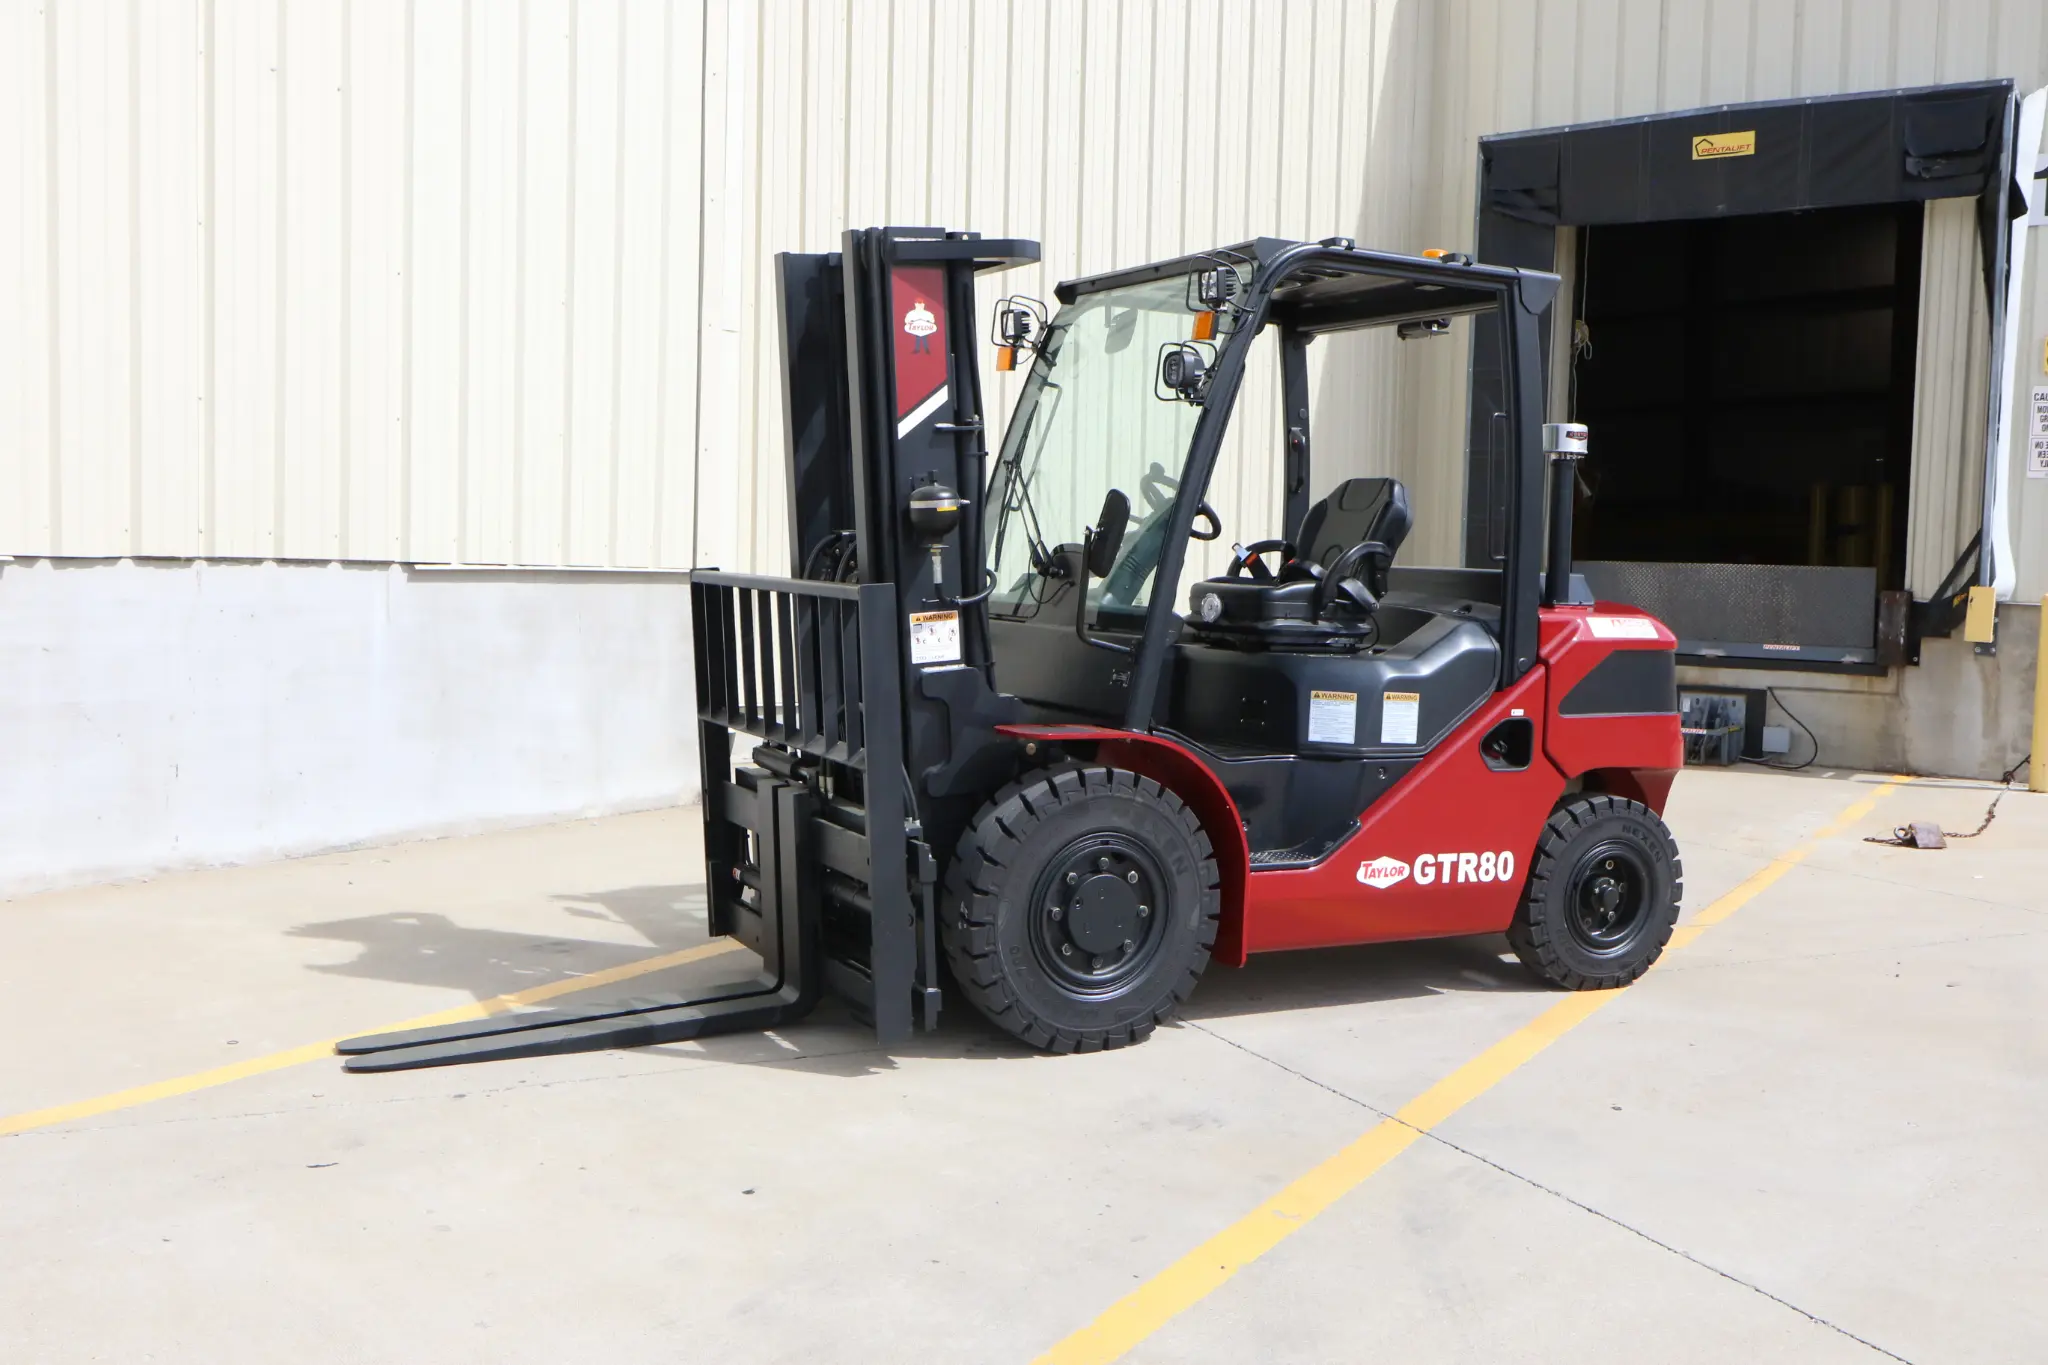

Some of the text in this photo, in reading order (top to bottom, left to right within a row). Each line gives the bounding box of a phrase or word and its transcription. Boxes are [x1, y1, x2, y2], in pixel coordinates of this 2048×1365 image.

[908, 322, 934, 331] TAYLOR
[922, 612, 953, 621] WARNING
[1321, 692, 1355, 701] WARNING
[1621, 823, 1663, 864] NEXEN
[1362, 850, 1515, 885] TAYLOR GTR80
